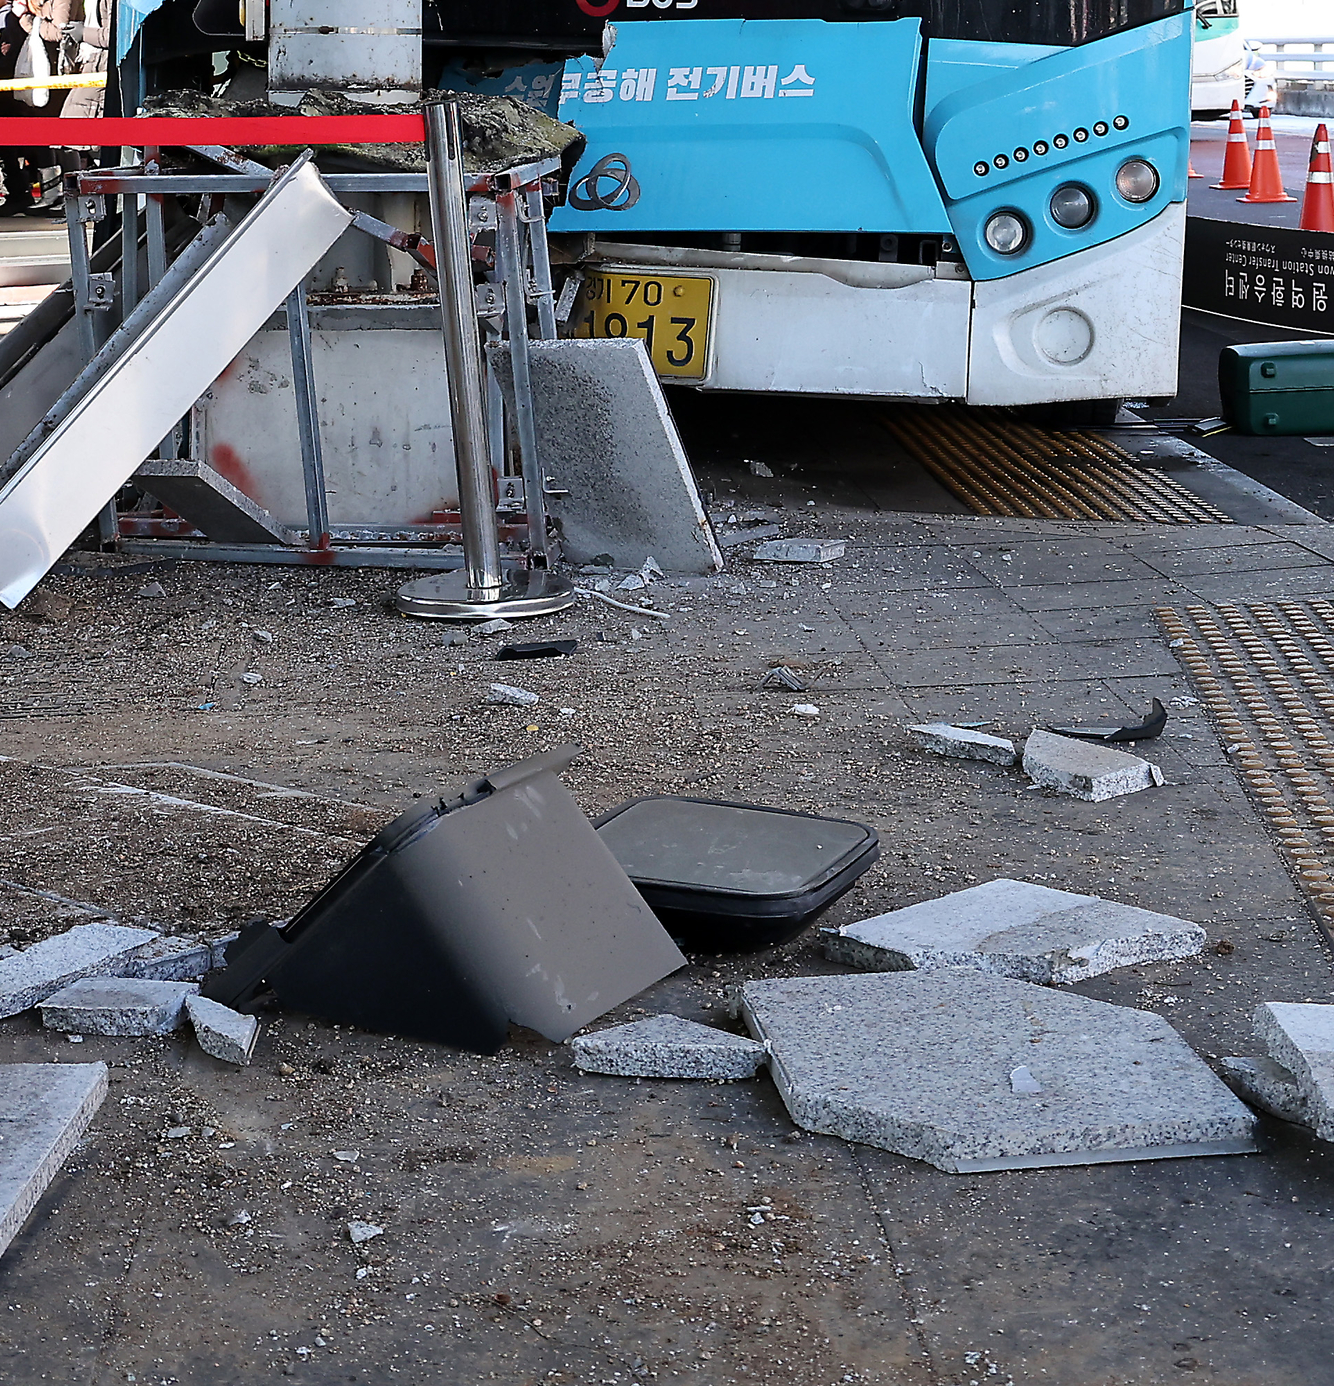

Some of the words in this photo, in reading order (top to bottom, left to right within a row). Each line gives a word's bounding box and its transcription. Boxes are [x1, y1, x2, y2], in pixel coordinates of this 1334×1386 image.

[666, 64, 816, 101] 전기버스
[1225, 252, 1247, 266] Center
[1248, 256, 1280, 272] Transfer
[1282, 260, 1315, 276] Station
[621, 279, 664, 306] 70
